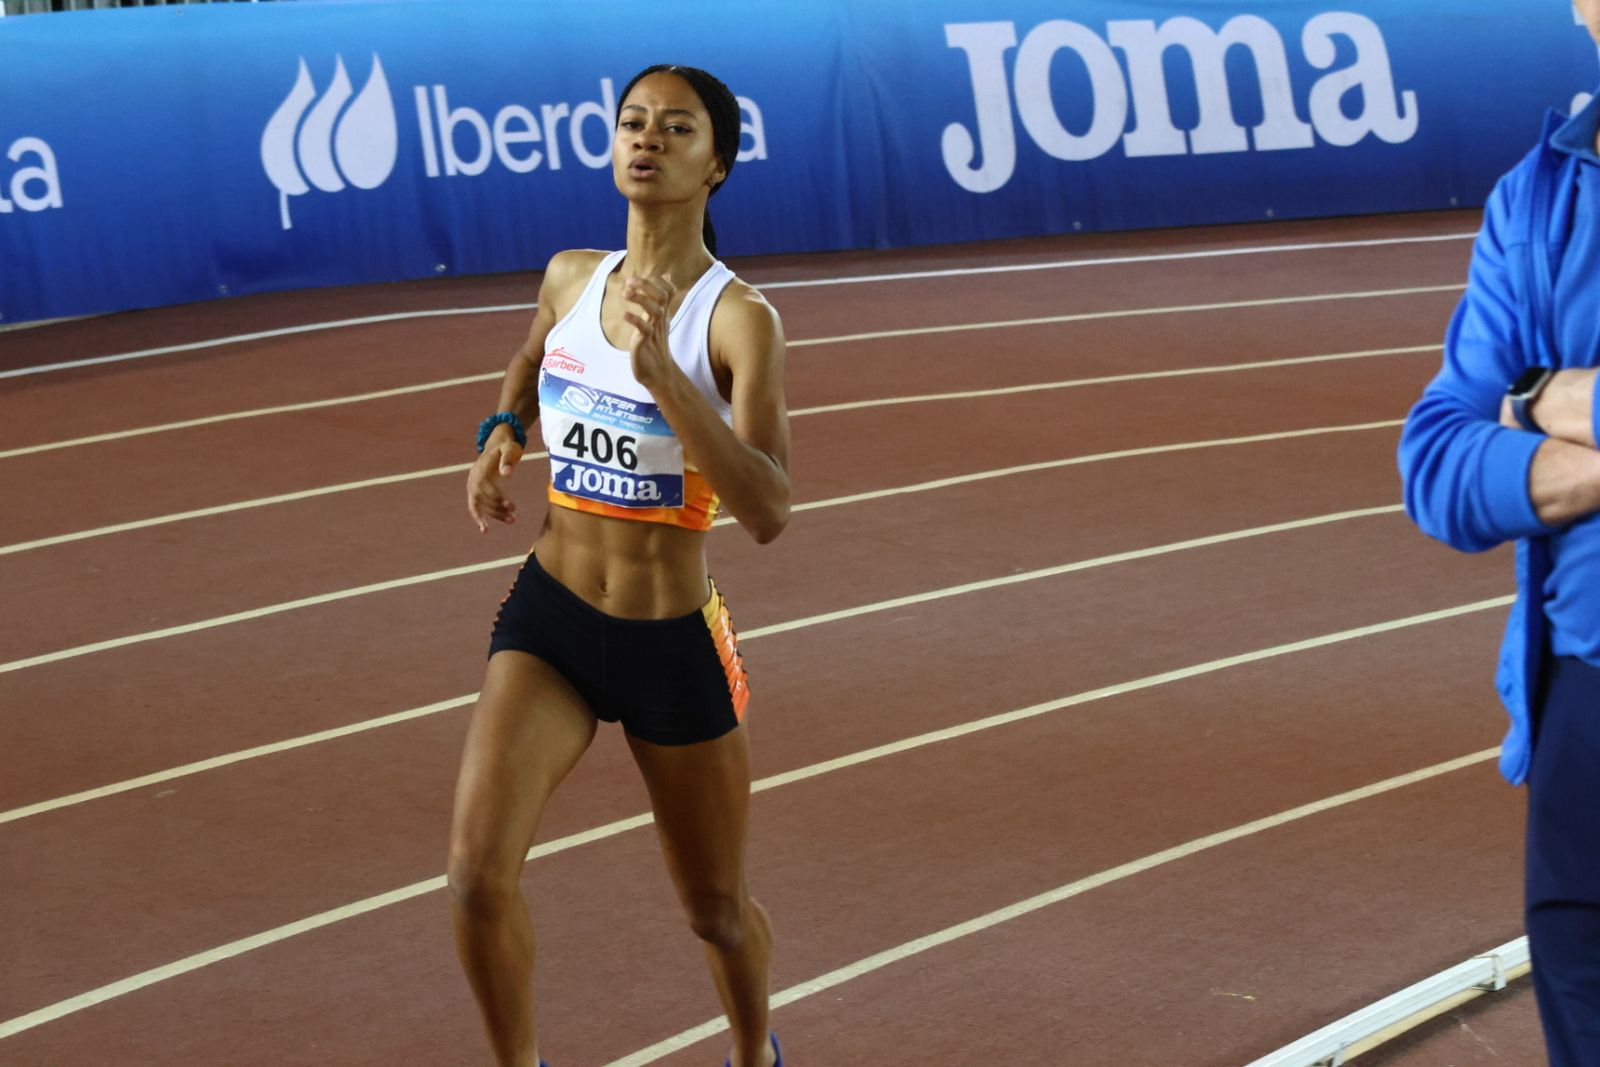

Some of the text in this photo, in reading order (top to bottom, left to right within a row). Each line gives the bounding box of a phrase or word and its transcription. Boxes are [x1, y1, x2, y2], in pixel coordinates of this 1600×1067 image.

[413, 77, 768, 178] Iberda
[942, 11, 1419, 194] Joma
[563, 421, 638, 471] 406
[566, 464, 662, 501] Joma
